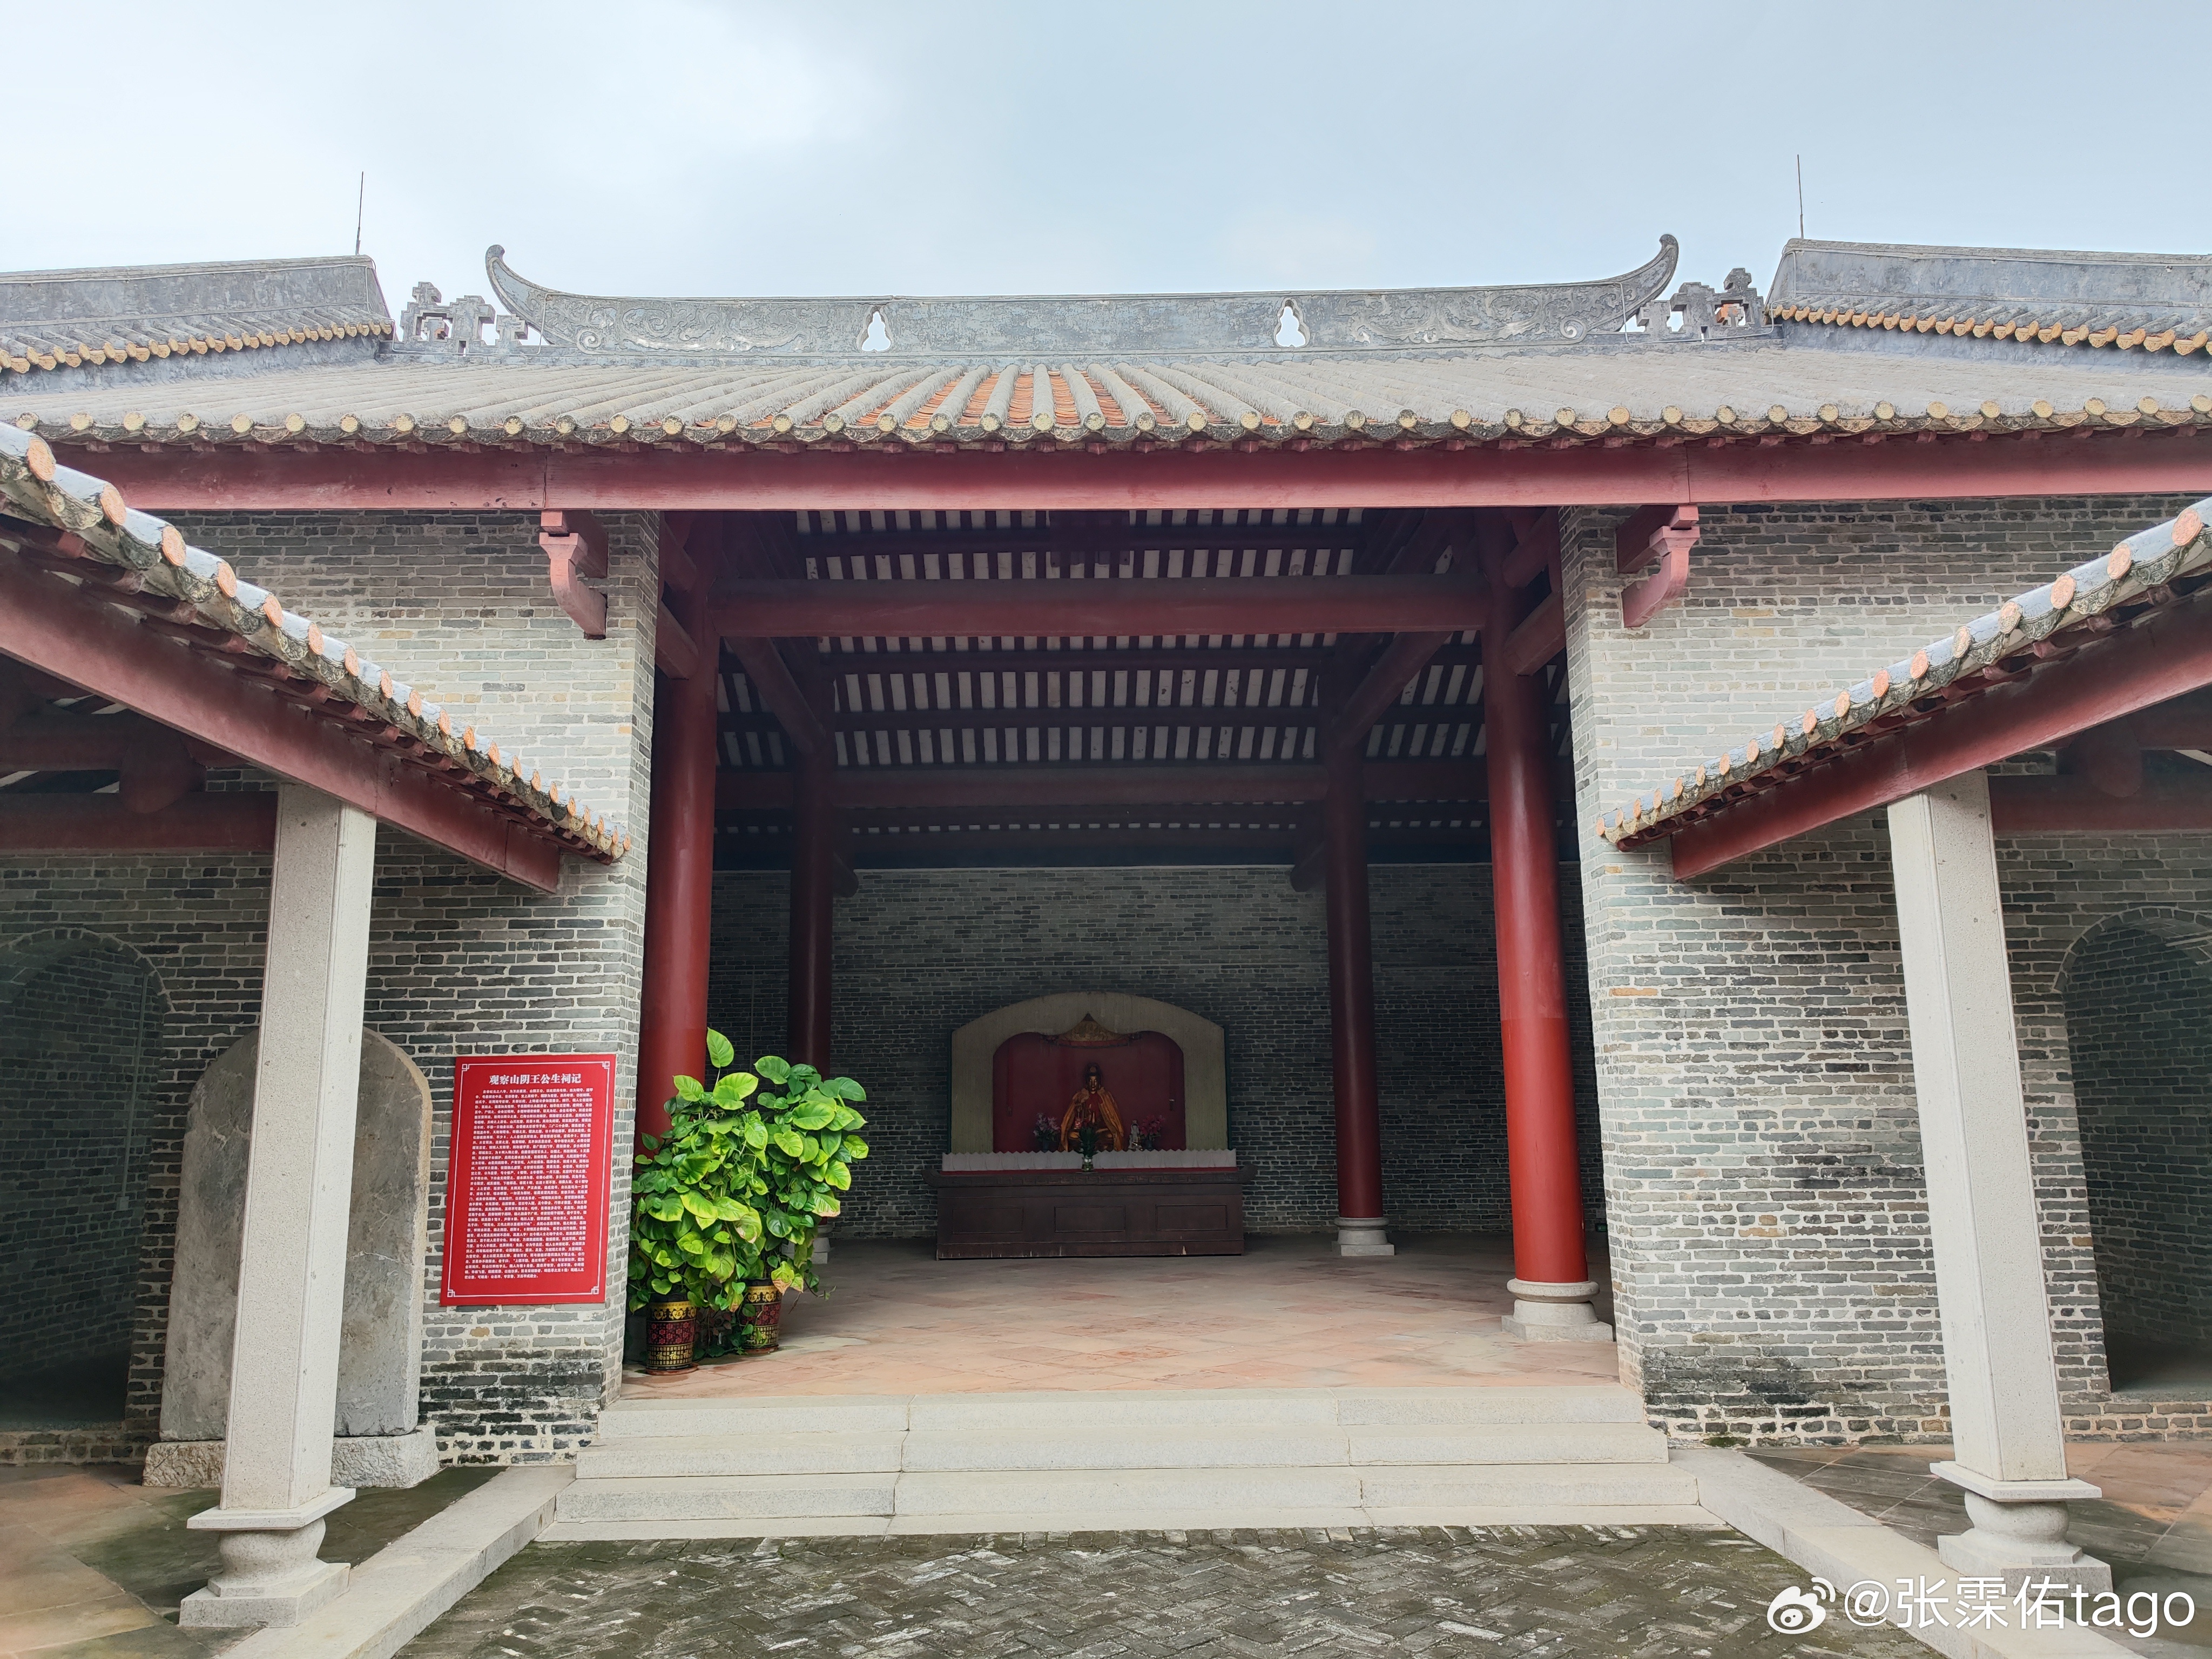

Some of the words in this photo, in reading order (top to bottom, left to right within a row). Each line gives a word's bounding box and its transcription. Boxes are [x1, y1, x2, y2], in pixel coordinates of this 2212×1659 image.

[489, 1073, 582, 1085] 观察山阴王公生祠记
